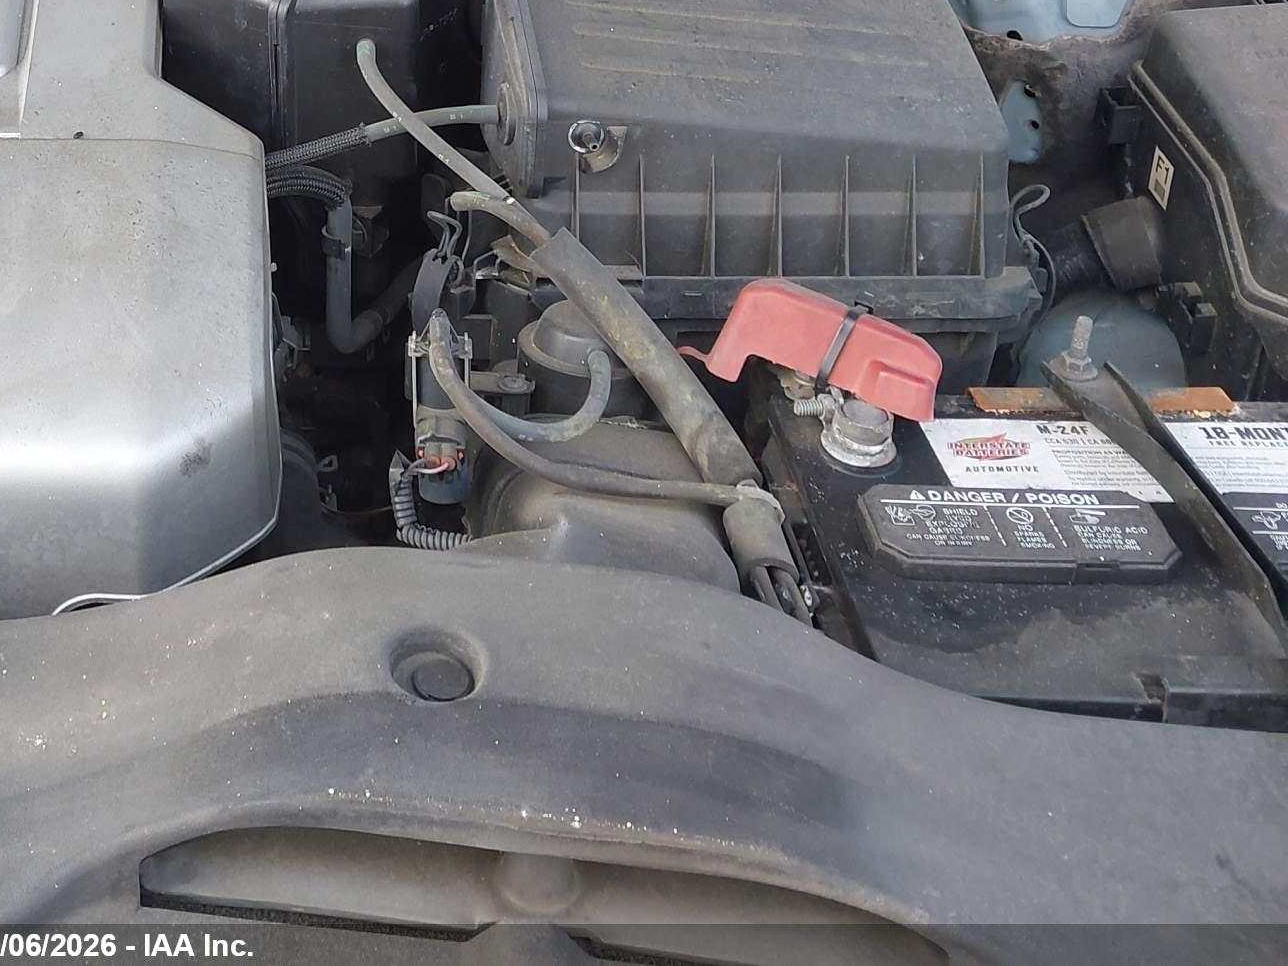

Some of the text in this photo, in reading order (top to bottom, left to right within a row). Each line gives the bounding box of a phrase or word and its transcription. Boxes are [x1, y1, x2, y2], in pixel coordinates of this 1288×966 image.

[947, 441, 1030, 450] INTERSTATE
[953, 449, 1030, 457] BATTERIES
[965, 465, 1040, 473] AUTOMOTIVE
[927, 490, 1008, 503] DANGER
[1025, 493, 1100, 505] POISON
[1017, 524, 1033, 532] NO
[1073, 524, 1148, 534] SULFURIC ACID
